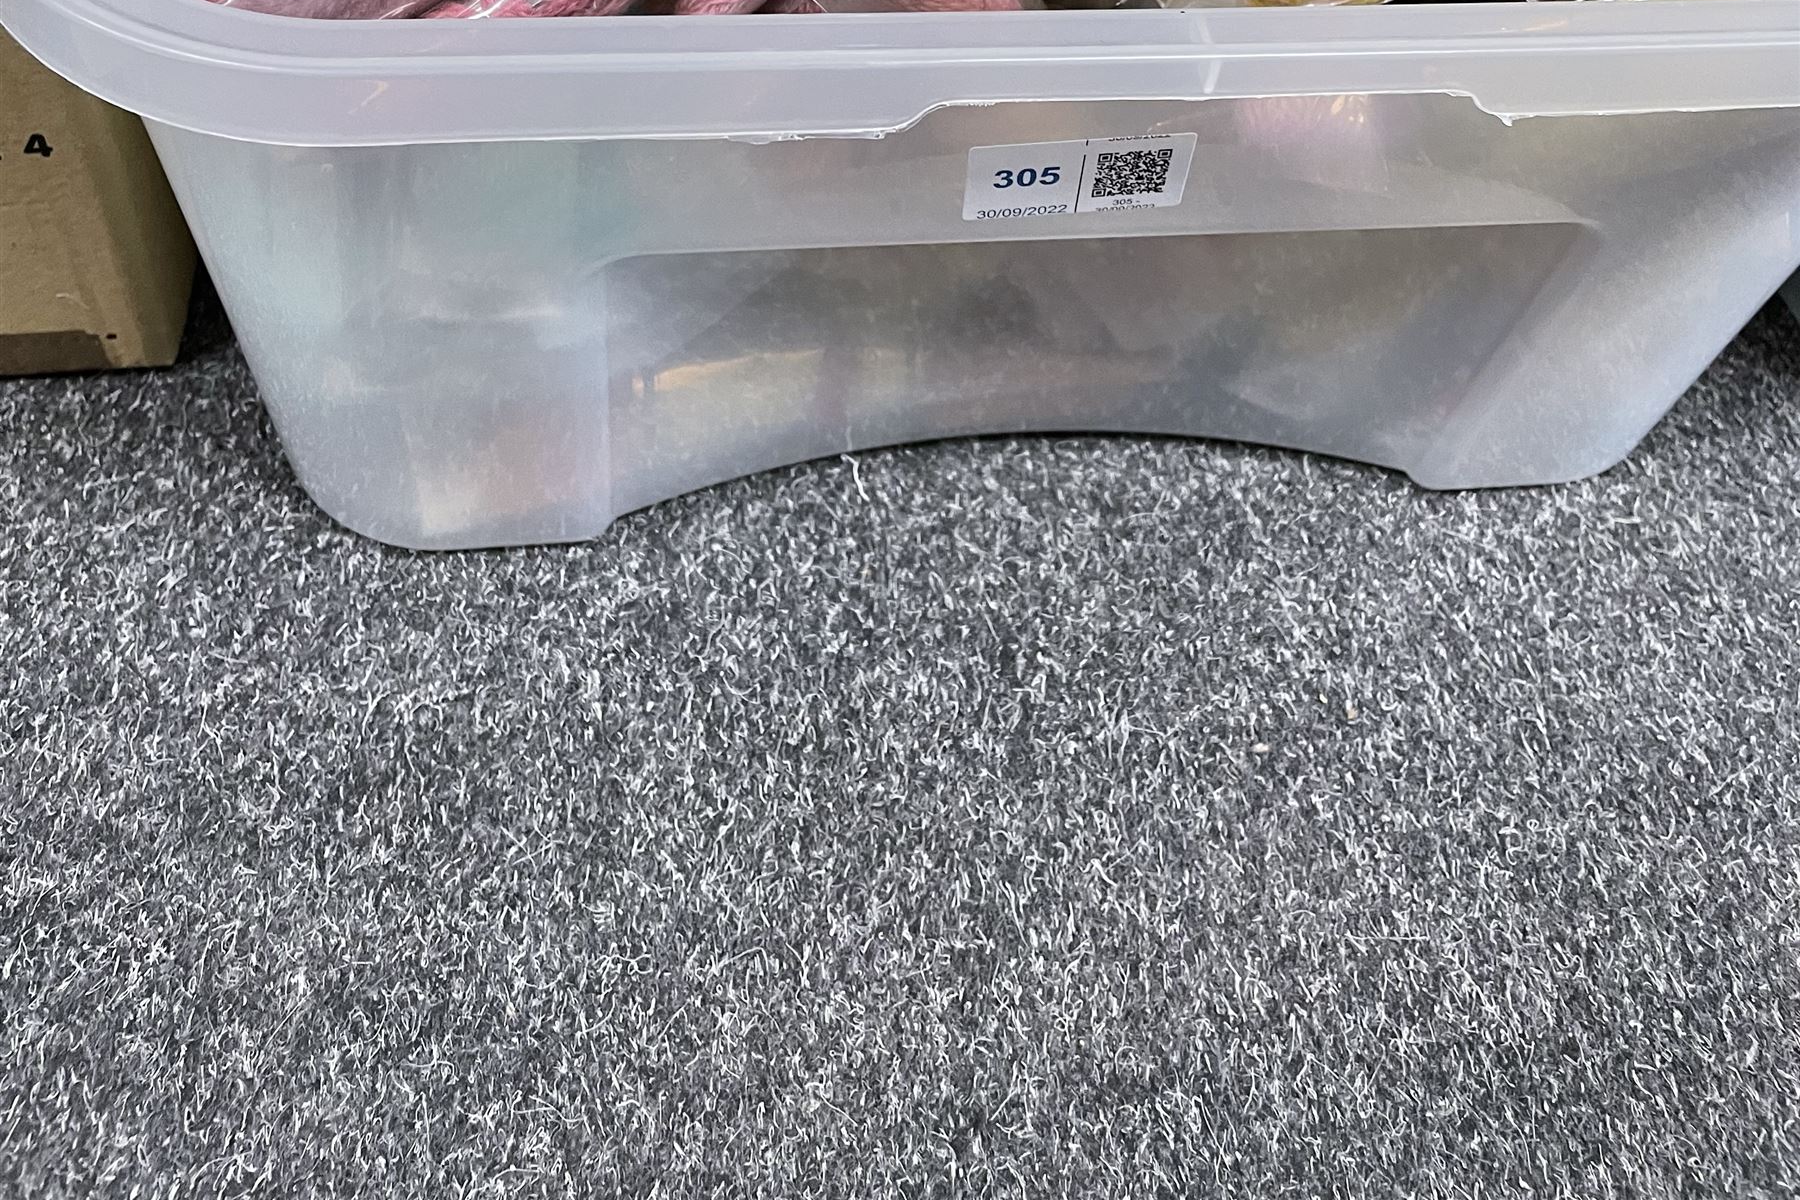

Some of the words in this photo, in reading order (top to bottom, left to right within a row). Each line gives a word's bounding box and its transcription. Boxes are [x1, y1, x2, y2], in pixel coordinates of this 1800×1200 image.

[23, 133, 53, 158] 4
[993, 166, 1061, 189] 305
[1112, 198, 1133, 206] 305
[976, 204, 1068, 220] 30/09/2022
